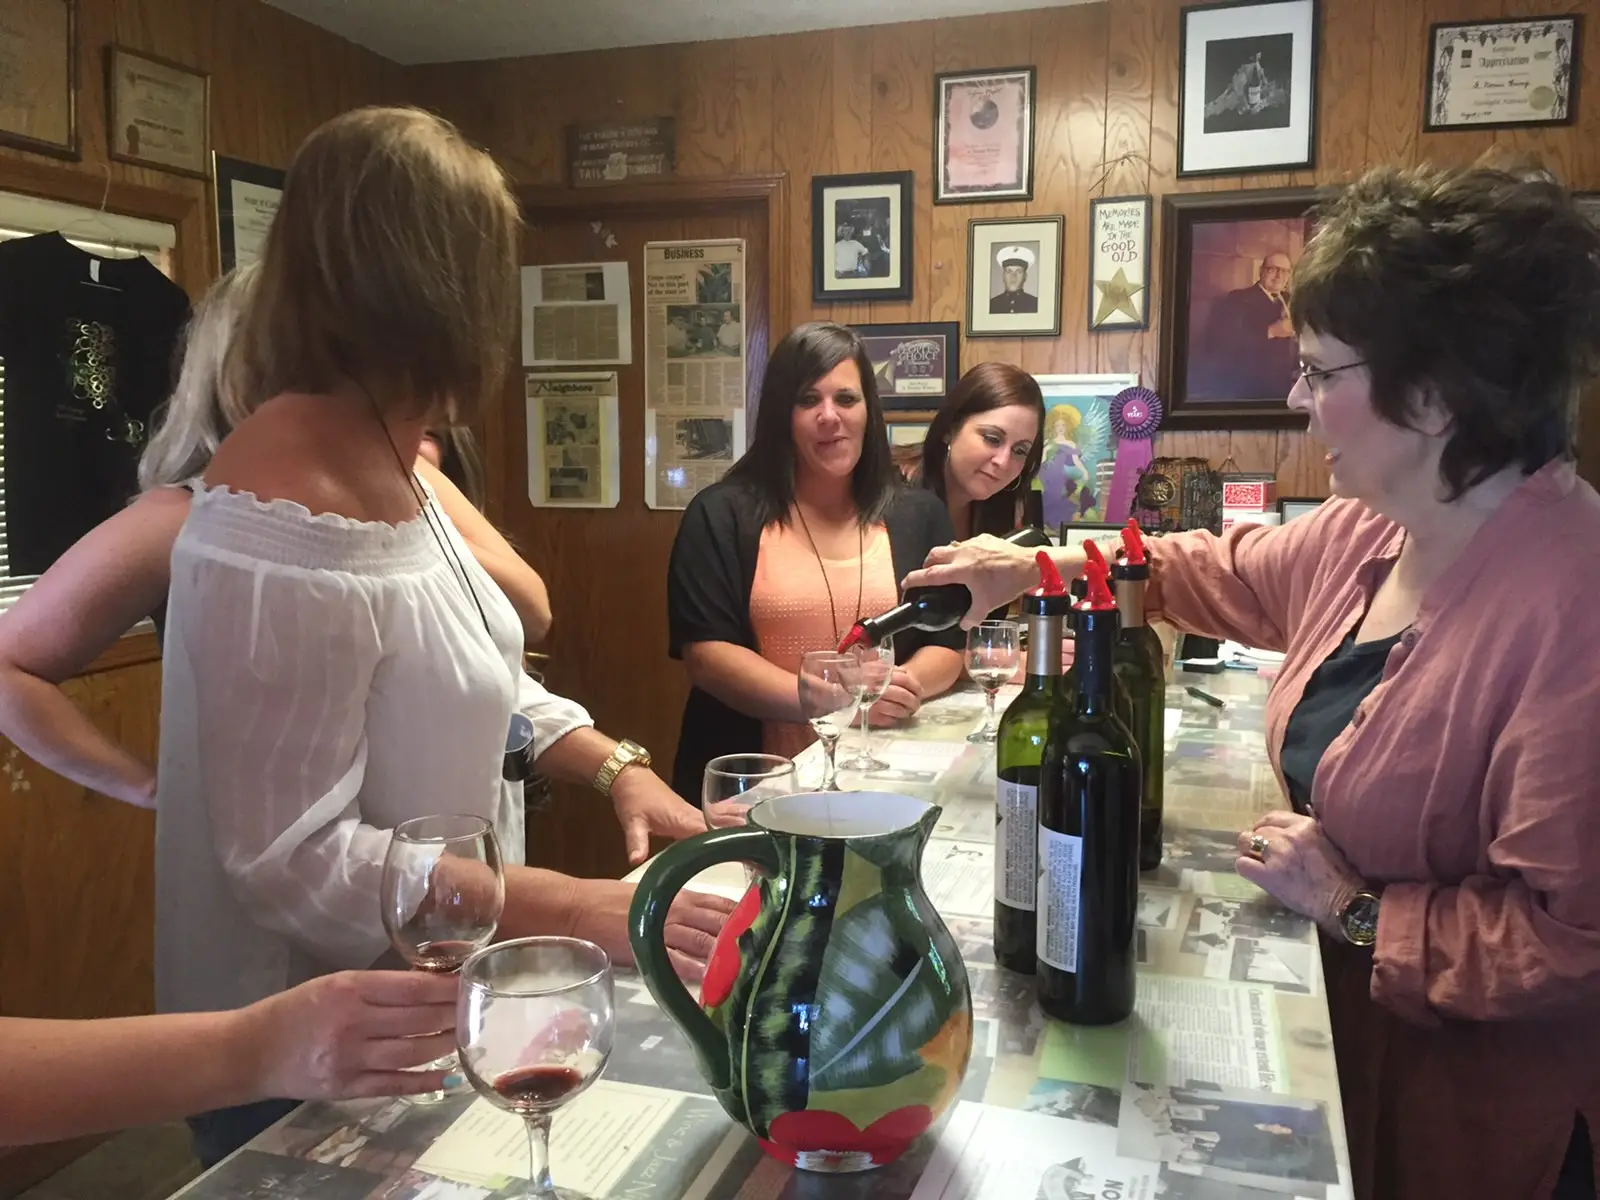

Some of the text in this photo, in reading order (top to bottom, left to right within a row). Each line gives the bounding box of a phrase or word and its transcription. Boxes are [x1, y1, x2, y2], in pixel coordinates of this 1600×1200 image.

[1101, 239, 1136, 253] GOOD
[664, 248, 705, 260] BUSINESS
[1111, 251, 1138, 263] OLD
